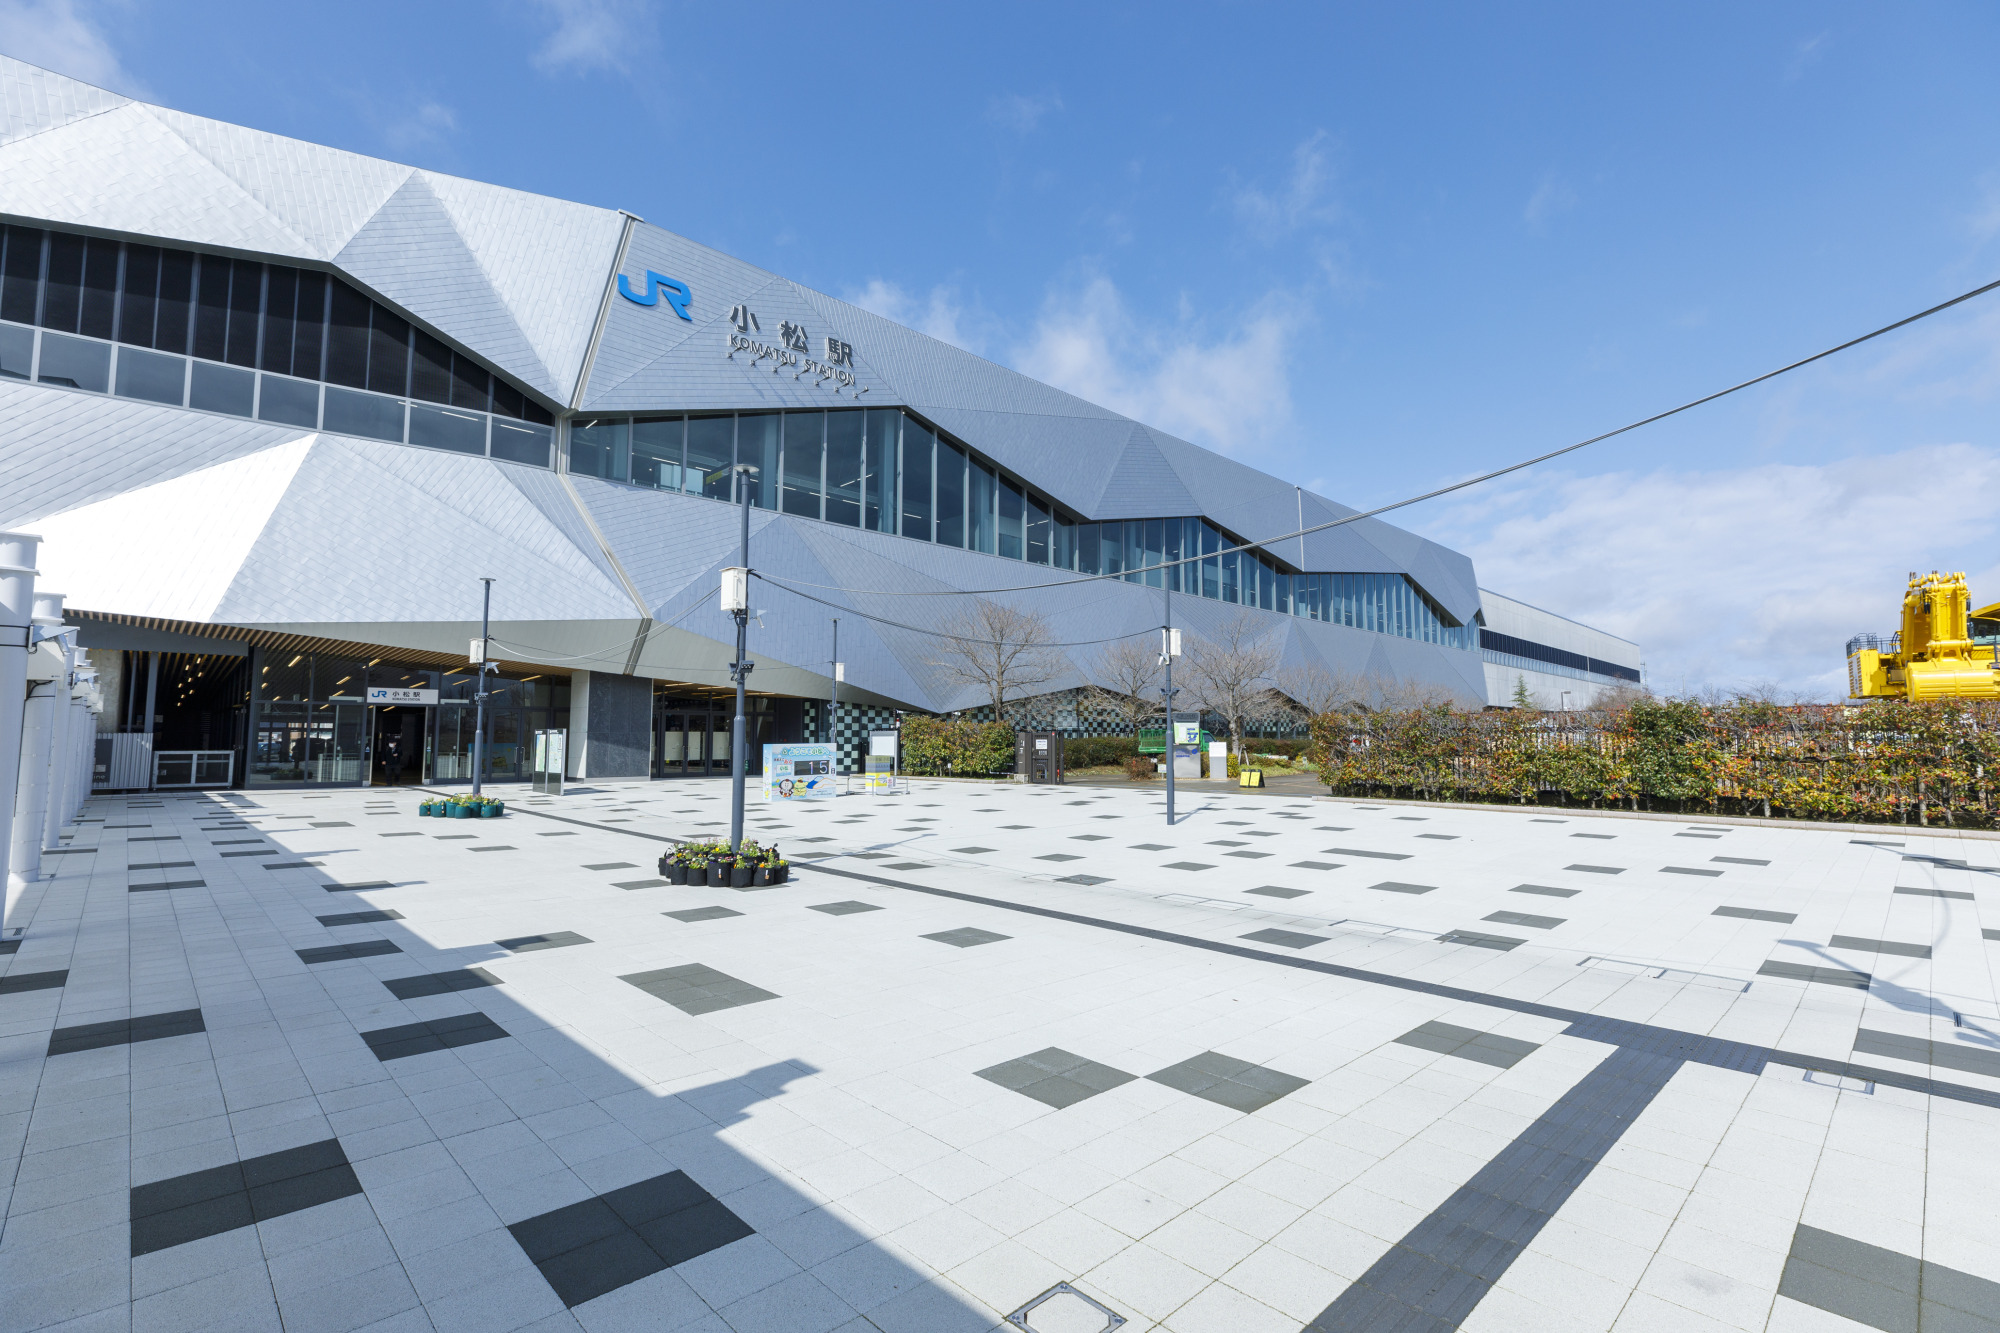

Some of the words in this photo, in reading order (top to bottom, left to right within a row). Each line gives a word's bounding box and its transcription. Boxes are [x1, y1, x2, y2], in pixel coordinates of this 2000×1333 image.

[617, 269, 692, 321] JR
[728, 334, 797, 366] KOMATSU
[803, 358, 856, 385] STATION
[729, 304, 853, 368] 小松駅
[372, 690, 387, 698] JR
[808, 760, 828, 775] 15
